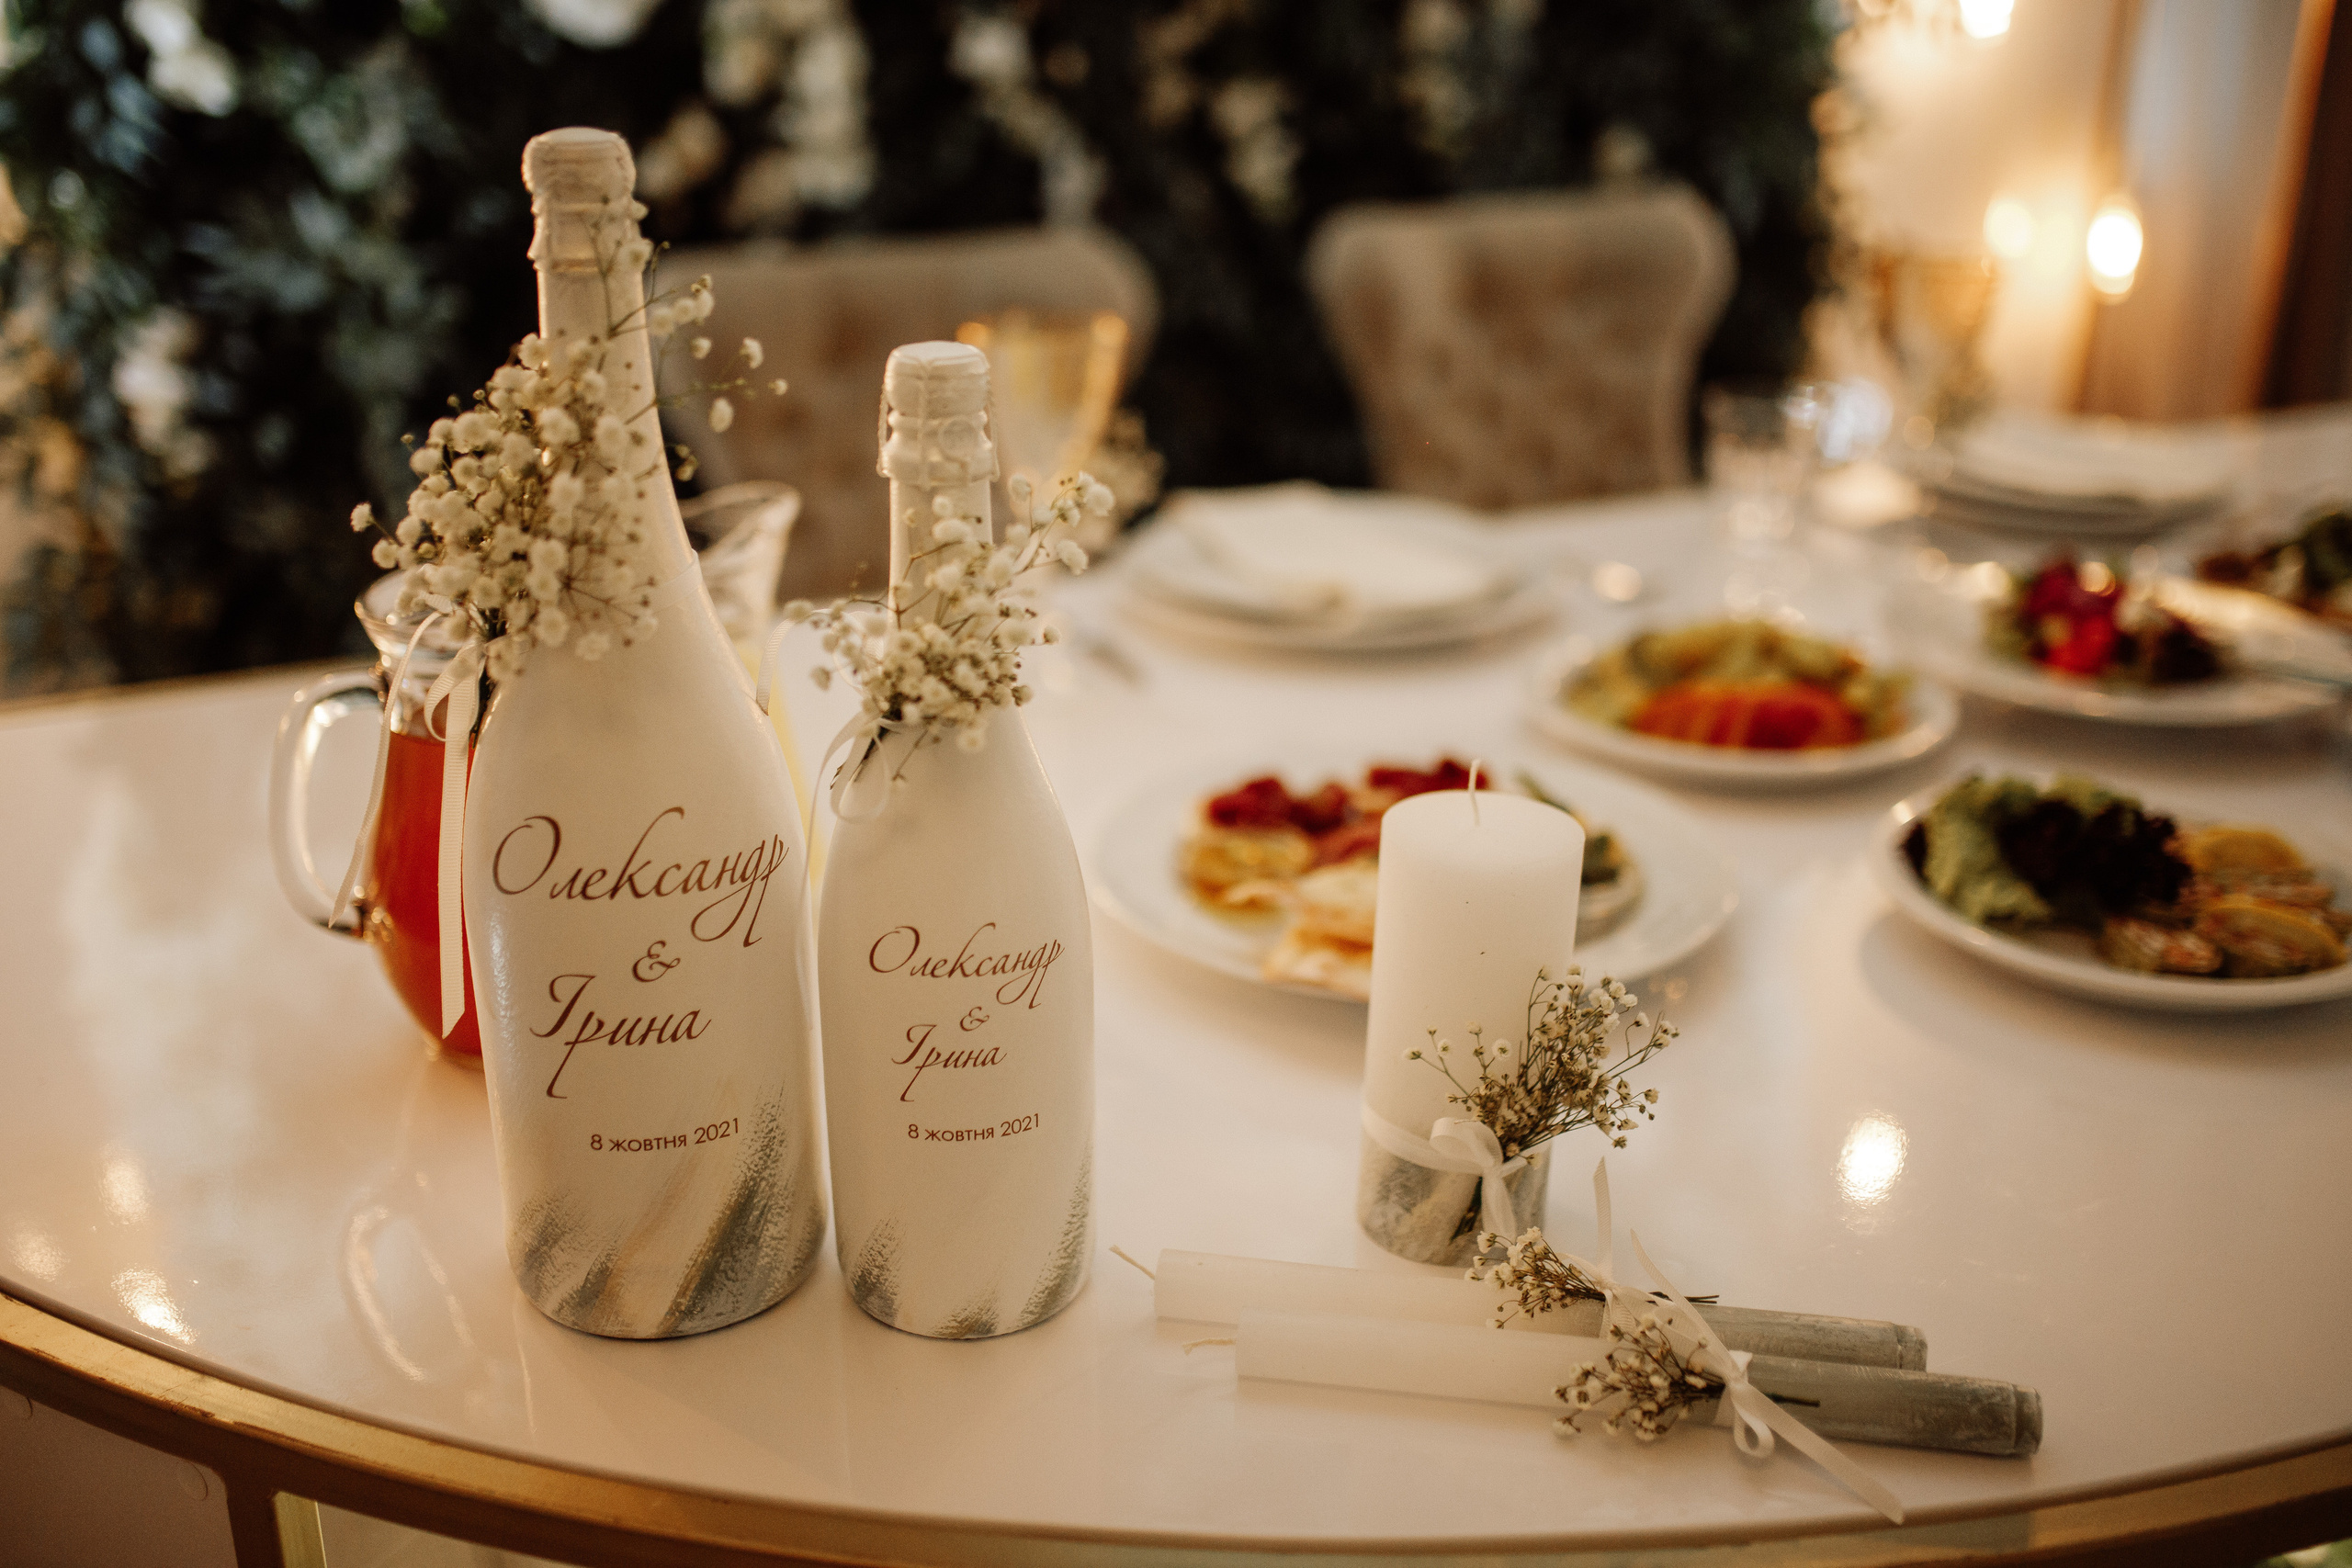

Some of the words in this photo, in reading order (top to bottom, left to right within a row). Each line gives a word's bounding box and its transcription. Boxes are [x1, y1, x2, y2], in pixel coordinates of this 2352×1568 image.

[492, 807, 790, 948] Олександр
[632, 940, 681, 983] &
[868, 921, 1066, 1010] Олександр
[529, 974, 712, 1100] Ірина
[959, 1006, 990, 1032] &
[891, 1023, 1008, 1102] Ірина
[590, 1134, 603, 1151] 8
[608, 1133, 688, 1153] жовтня
[694, 1117, 740, 1145] 2021
[908, 1123, 920, 1139] 8
[924, 1126, 995, 1142] жовтня
[1000, 1112, 1039, 1137] 2021
